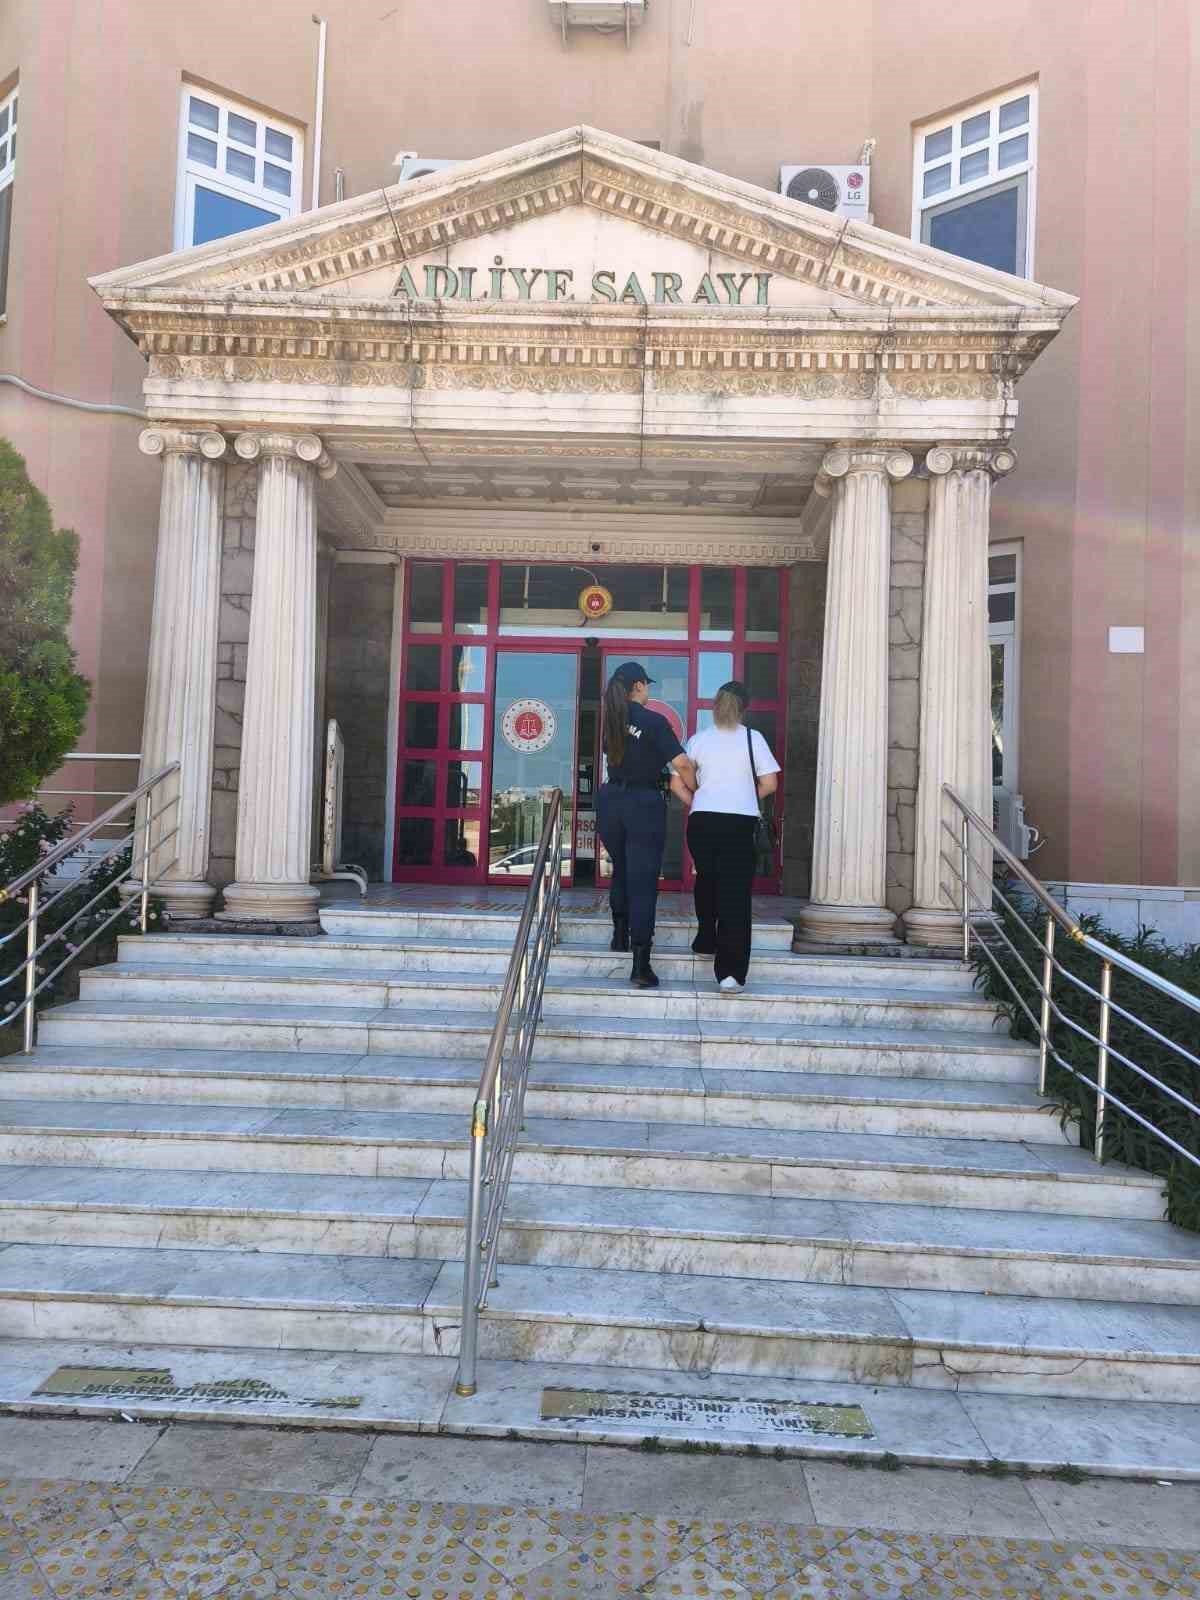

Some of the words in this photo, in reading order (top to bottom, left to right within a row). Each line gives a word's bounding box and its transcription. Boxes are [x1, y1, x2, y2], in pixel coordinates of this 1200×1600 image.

[847, 191, 861, 200] LG
[391, 255, 575, 303] ADLİYE
[591, 270, 773, 306] SARAYI
